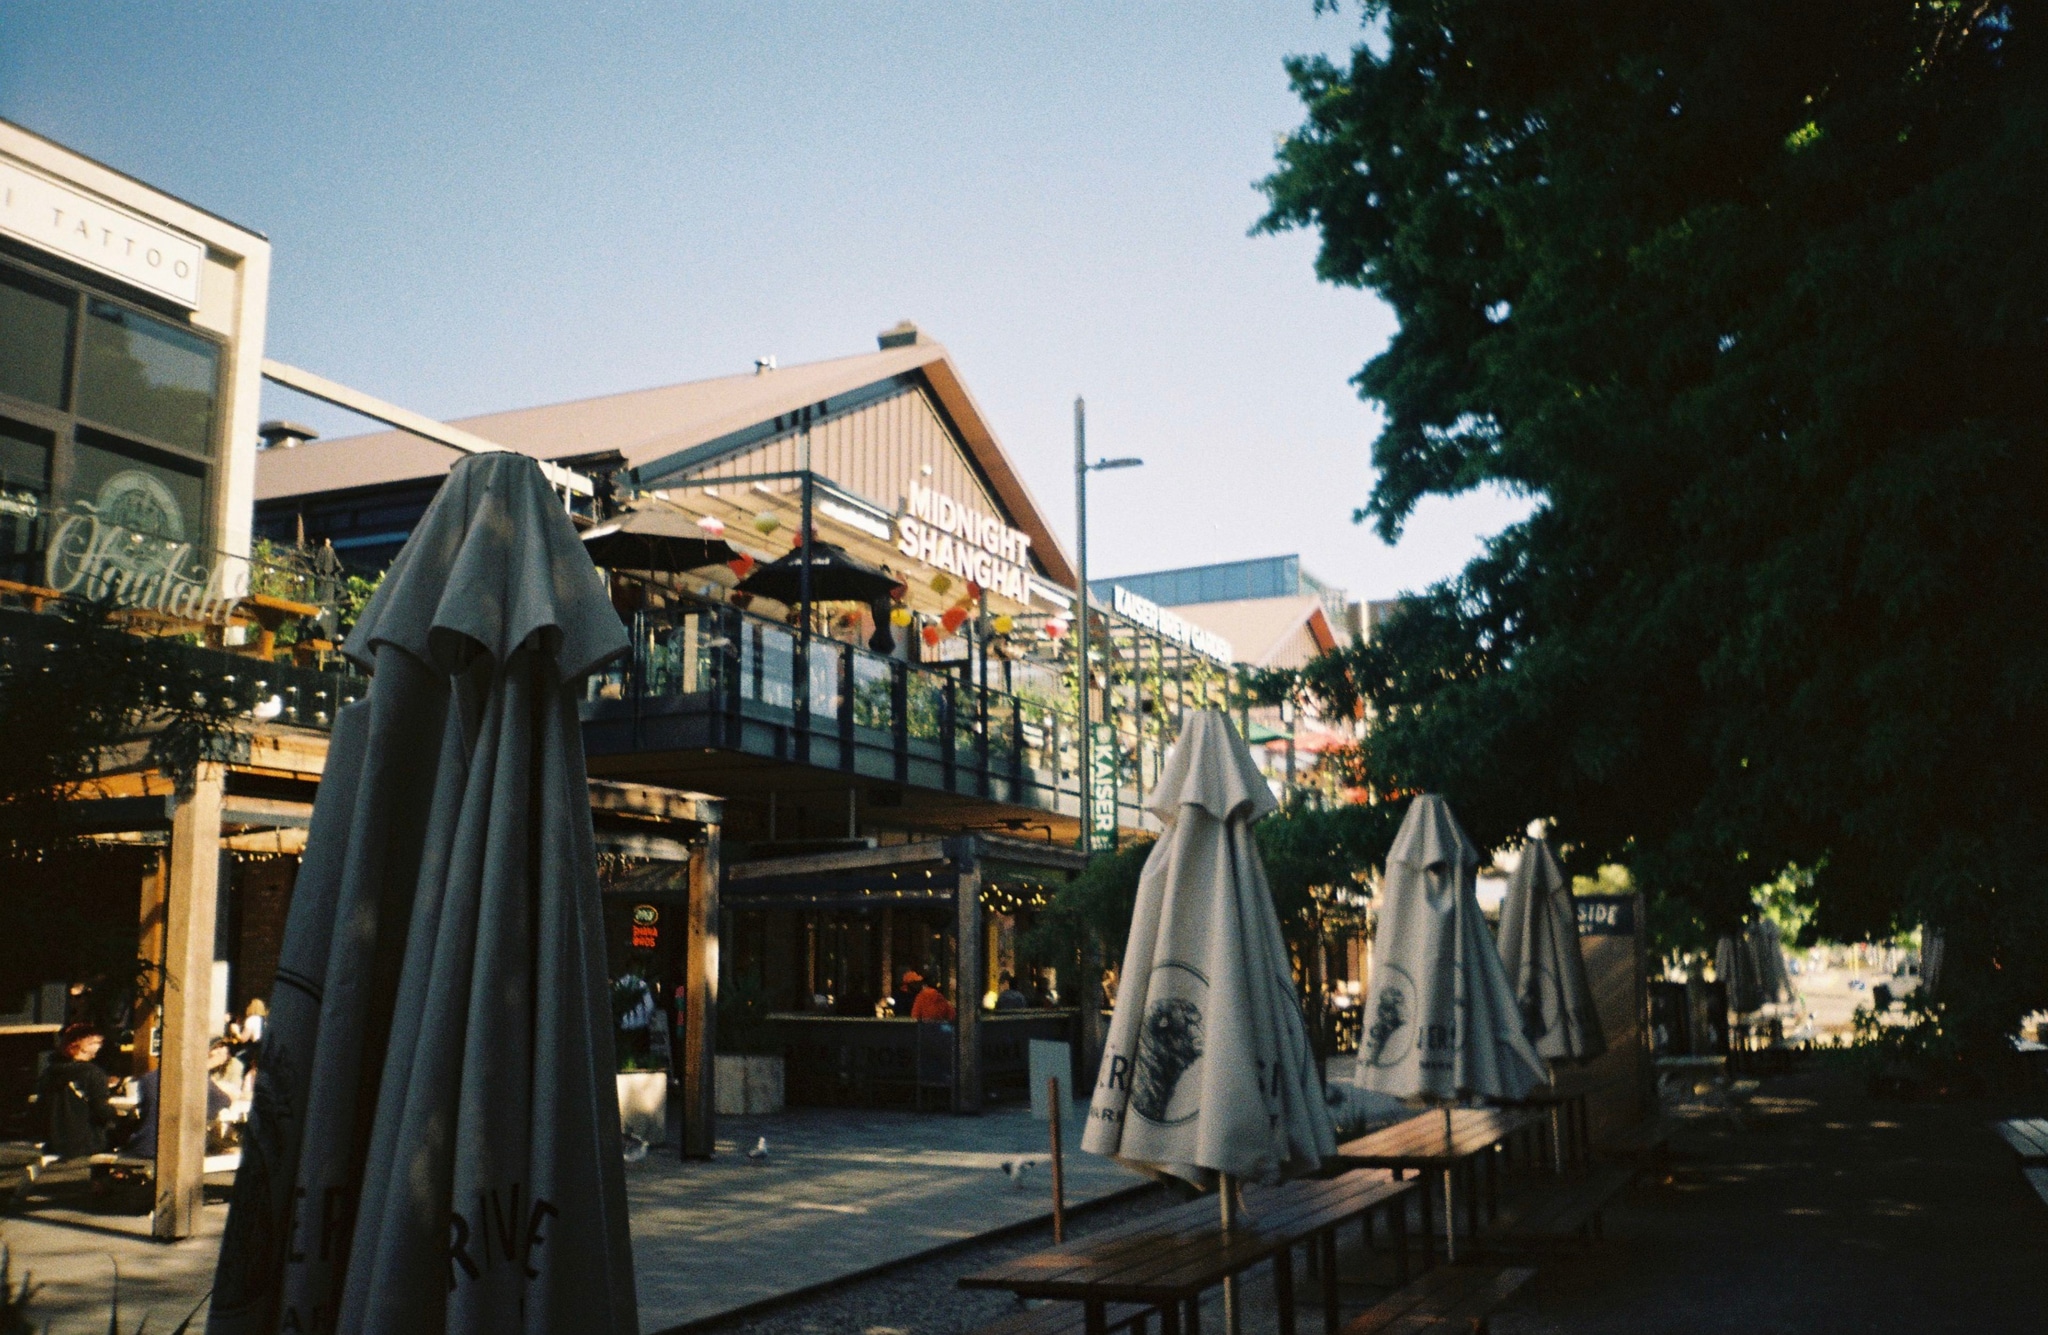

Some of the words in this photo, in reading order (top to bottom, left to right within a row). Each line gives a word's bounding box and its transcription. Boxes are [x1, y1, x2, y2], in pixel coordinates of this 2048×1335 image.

[53, 208, 190, 280] TATTOO
[898, 516, 1030, 606] SHANGHAI
[909, 479, 1031, 568] MIDNIGHT
[1114, 583, 1159, 632] KAISER
[1158, 606, 1192, 648] BREW
[1191, 624, 1232, 667] GARDEN
[1095, 744, 1115, 832] KAISER
